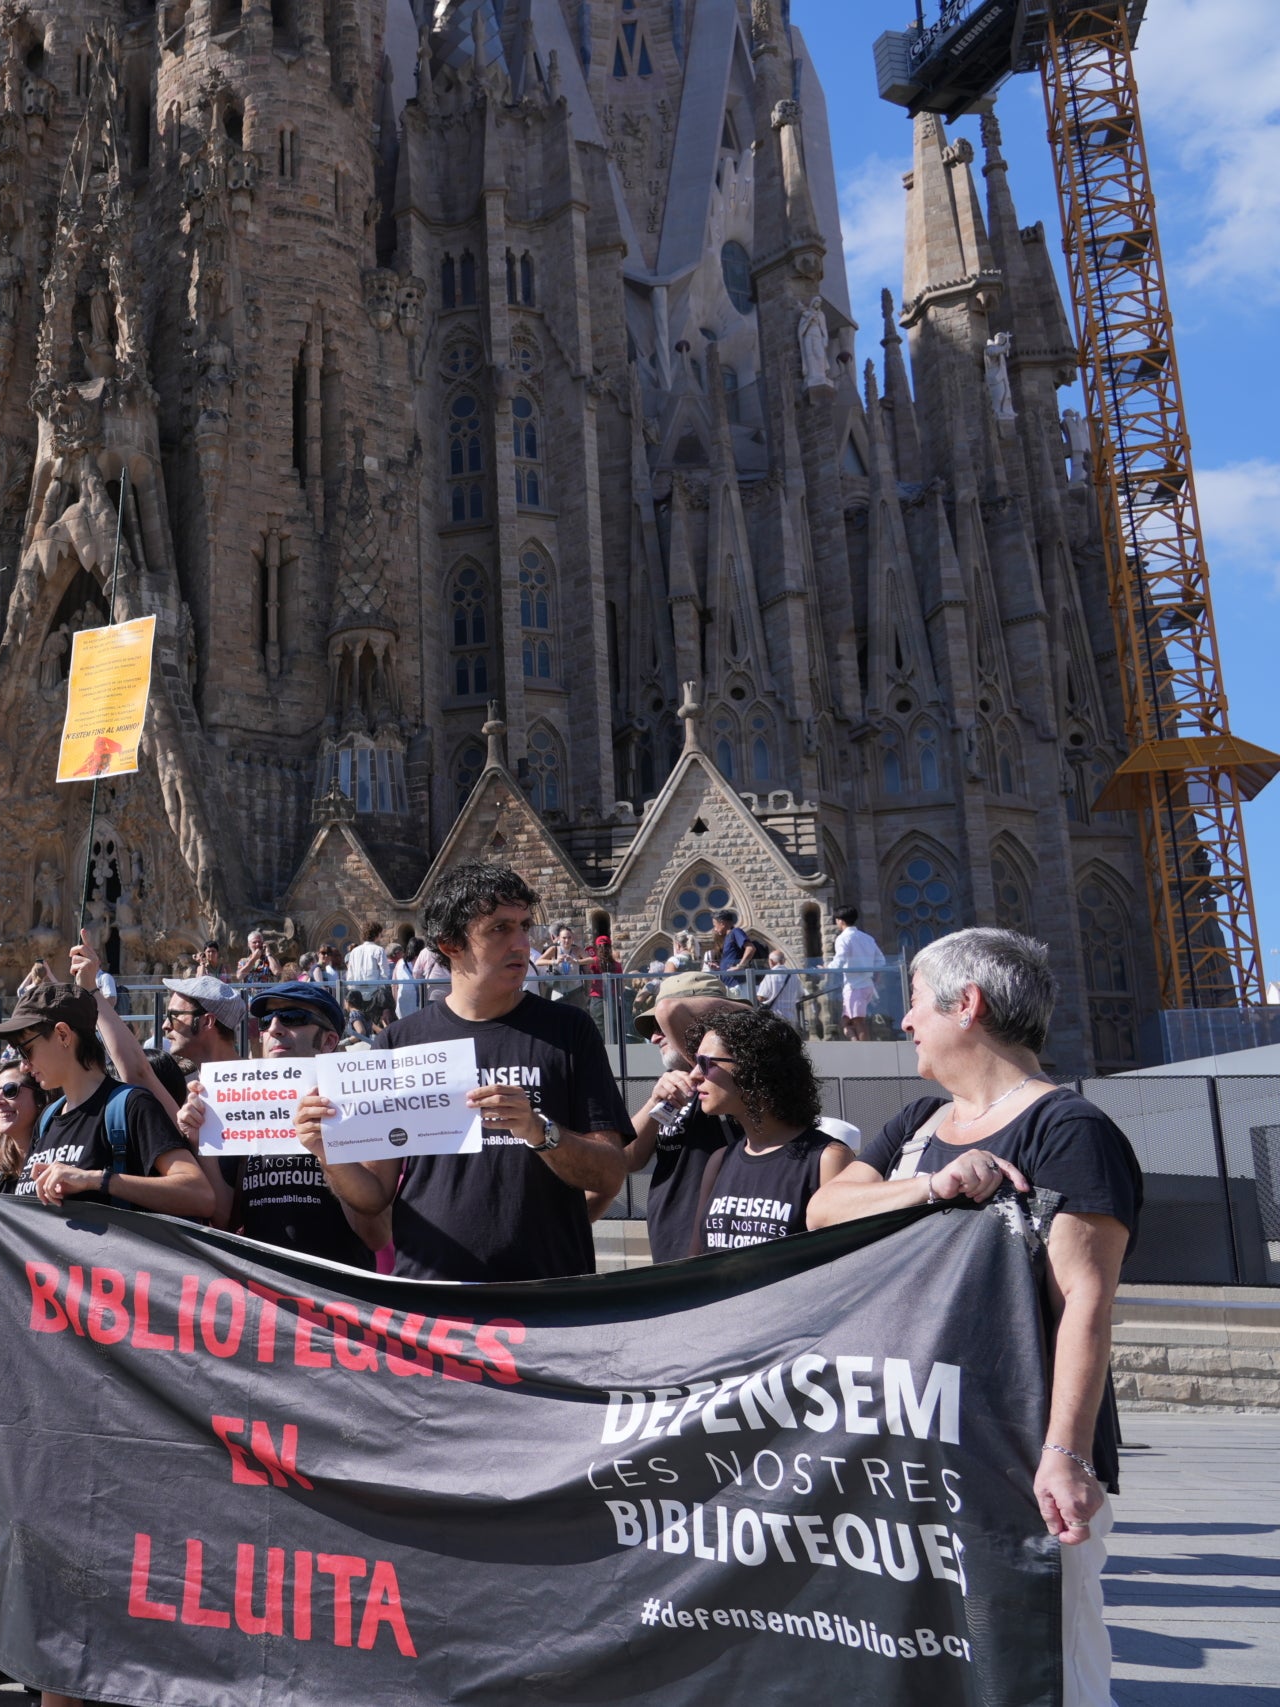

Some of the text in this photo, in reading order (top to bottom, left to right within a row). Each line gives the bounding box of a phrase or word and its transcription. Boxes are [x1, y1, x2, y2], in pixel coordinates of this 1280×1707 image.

[950, 6, 1003, 56] LIEBHERR
[337, 1052, 447, 1073] VOLEM BIBLIOS
[214, 1067, 302, 1083] Les rates de
[341, 1071, 447, 1095] LLIURES DE
[216, 1087, 298, 1103] biblioteca
[342, 1093, 451, 1118] VIOLÈNCIES
[225, 1107, 291, 1121] estan als
[221, 1127, 297, 1142] despatxos
[706, 1218, 787, 1237] LES NOSTRES
[600, 1354, 961, 1445] DEFENSEM
[211, 1414, 314, 1491] EN
[586, 1449, 962, 1513] LES NOSTRES
[127, 1532, 418, 1658] LLUITA
